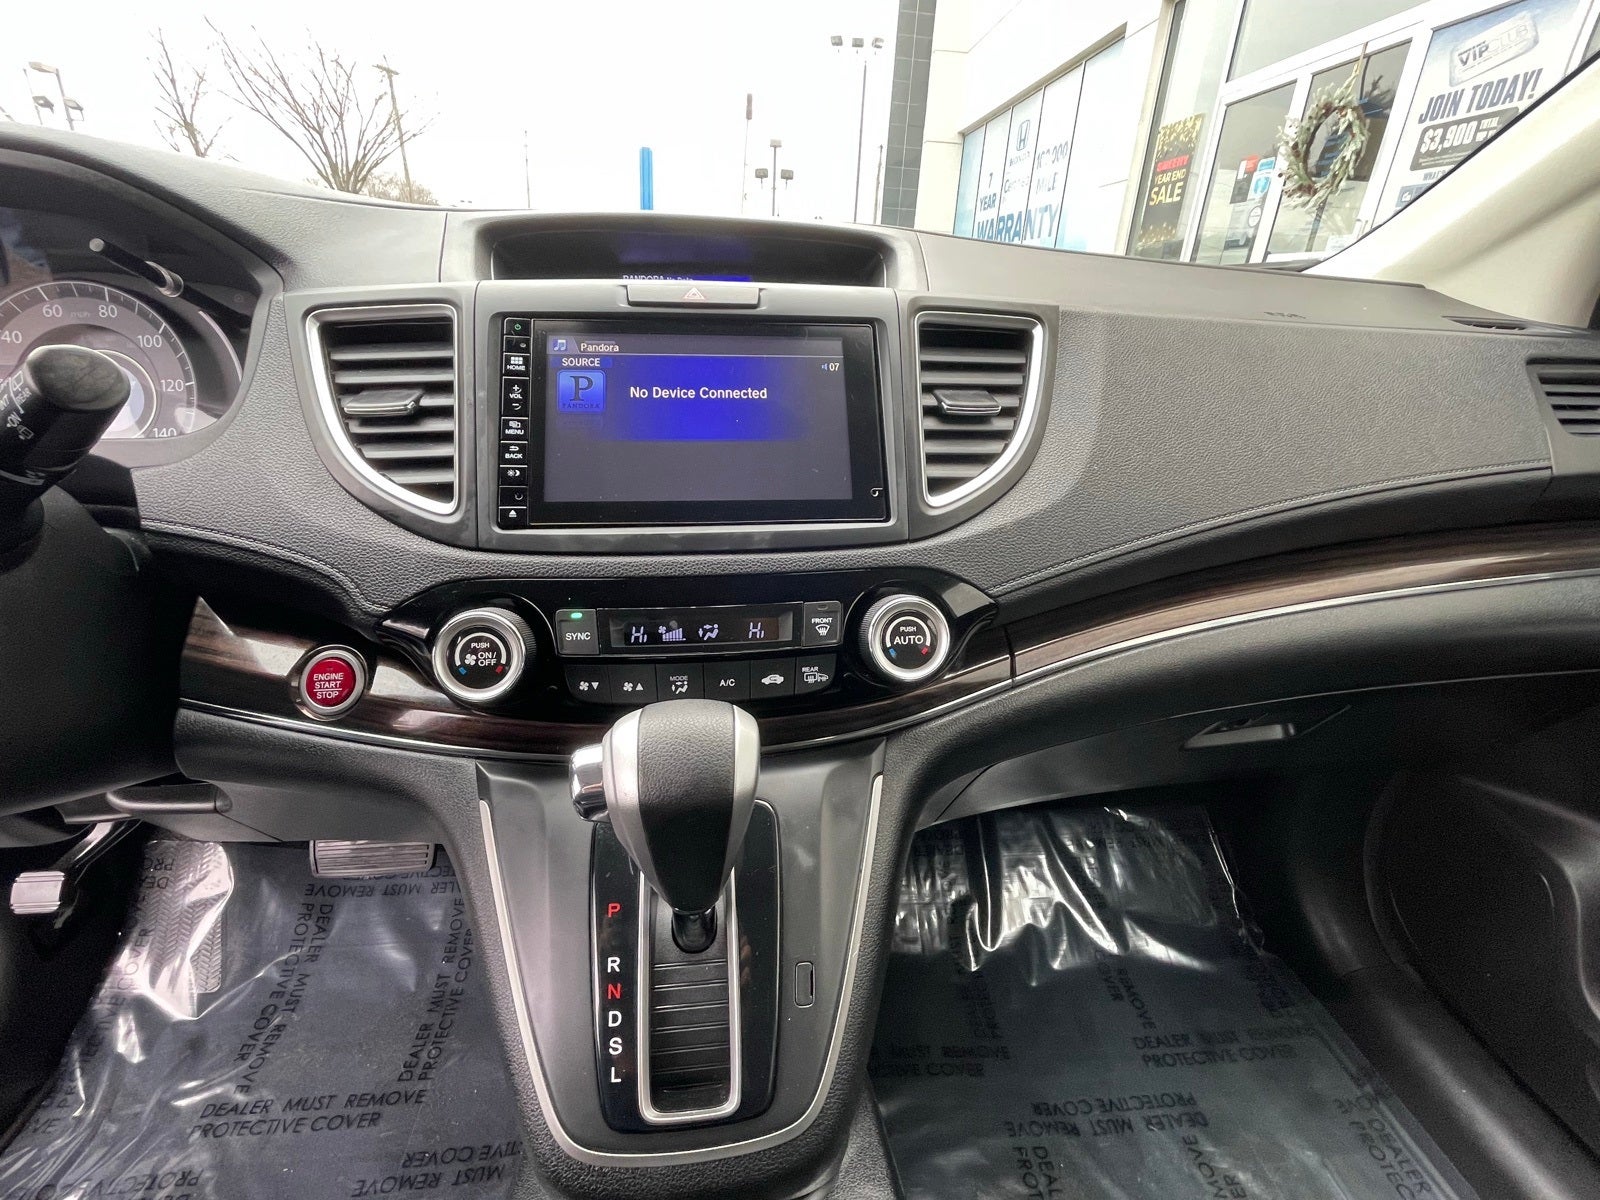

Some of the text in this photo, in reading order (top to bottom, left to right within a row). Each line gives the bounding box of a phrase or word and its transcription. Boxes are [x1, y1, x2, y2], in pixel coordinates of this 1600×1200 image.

[1458, 41, 1490, 66] VIP
[1418, 68, 1544, 124] JOIN TODAY!
[1420, 121, 1478, 154] $3,900
[1171, 168, 1187, 181] END
[1149, 181, 1184, 206] SALE
[980, 193, 997, 212] YEAR
[977, 203, 1060, 242] WARRANTY
[43, 304, 63, 318] 60
[98, 304, 118, 318] 80
[1, 331, 23, 344] 40
[138, 335, 162, 348] 100
[580, 342, 620, 352] Pandora
[562, 357, 601, 367] SOURCE
[828, 363, 840, 372] 07
[161, 379, 184, 392] 120
[630, 386, 768, 399] No Device Connected
[153, 427, 177, 437] 140
[565, 632, 591, 641] SYNC
[893, 635, 924, 645] AUTO
[478, 659, 497, 667] OFF
[313, 673, 344, 681] ENGINE
[314, 681, 341, 689] START
[719, 679, 736, 687] A/C
[316, 691, 339, 699] STOP
[304, 883, 375, 897] REMOVE
[382, 883, 421, 896] MUST
[607, 903, 621, 918] P
[607, 957, 621, 973] R
[233, 903, 315, 1063] PROTECTIVE COVER
[397, 898, 465, 1082] DEALER MUST REMOVE
[233, 904, 334, 1095] DEALER MUST REMOVE
[607, 983, 622, 1000] N
[608, 1010, 622, 1028] D
[418, 987, 465, 1081] PROTECTIVE
[1132, 1033, 1193, 1050] DEALER
[608, 1037, 623, 1056] S
[1141, 1048, 1238, 1068] PROTECTIVE
[610, 1067, 622, 1083] L
[200, 1089, 427, 1119] DEALER MUST REMOVE
[1030, 1092, 1198, 1117] PROTECTIVE COVER
[188, 1112, 382, 1139] PROTECTIVE COVER
[1003, 1111, 1209, 1138] DEALER MUST REMOVE
[402, 1146, 474, 1169] COVER
[351, 1164, 506, 1198] MUST REMOVE
